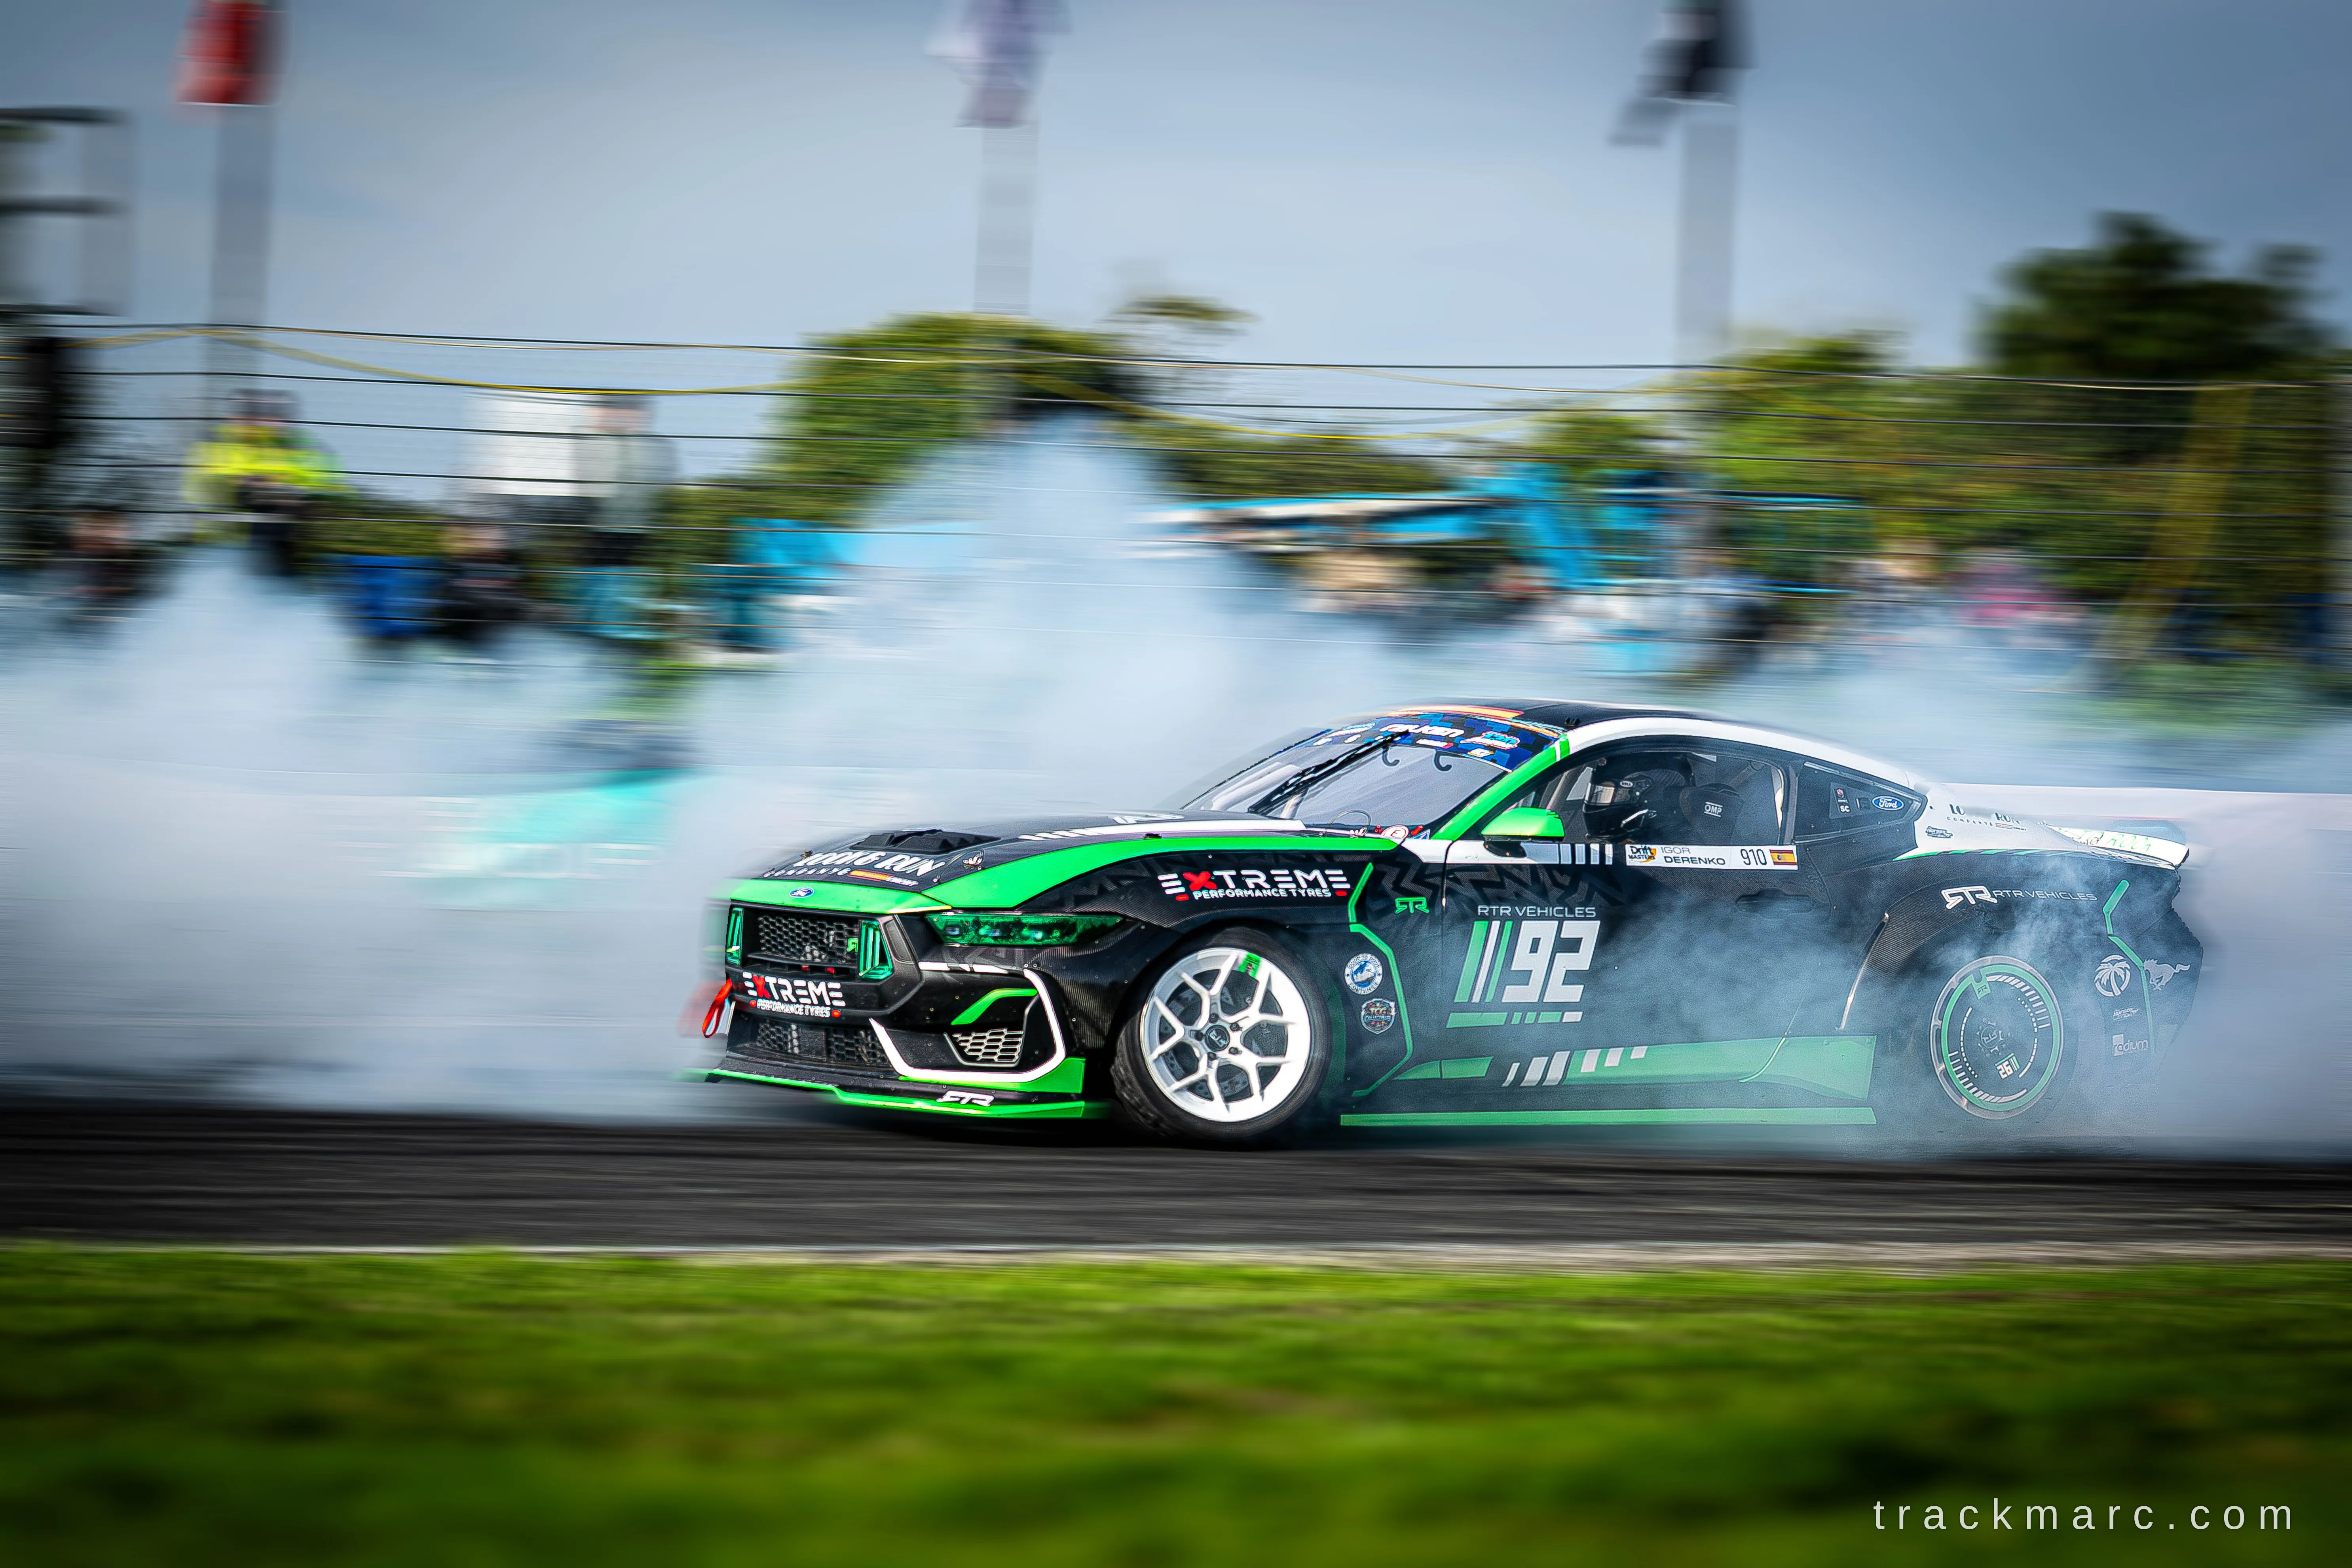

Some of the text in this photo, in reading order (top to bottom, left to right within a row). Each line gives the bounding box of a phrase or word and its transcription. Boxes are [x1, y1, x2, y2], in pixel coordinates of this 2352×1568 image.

[1704, 804, 1722, 814] OMP
[1629, 845, 1654, 855] Drift
[1664, 856, 1726, 866] DERENKO
[1741, 849, 1767, 866] 910
[1157, 869, 1351, 894] EXTREME
[1192, 888, 1332, 900] PERFORMANCE TYRES
[2025, 890, 2098, 901] VEHICLES
[1478, 905, 1596, 918] RTR VEHICLES
[1502, 921, 1601, 1003] 92
[742, 971, 846, 1007] EXTREME
[805, 1005, 831, 1017] TYRES
